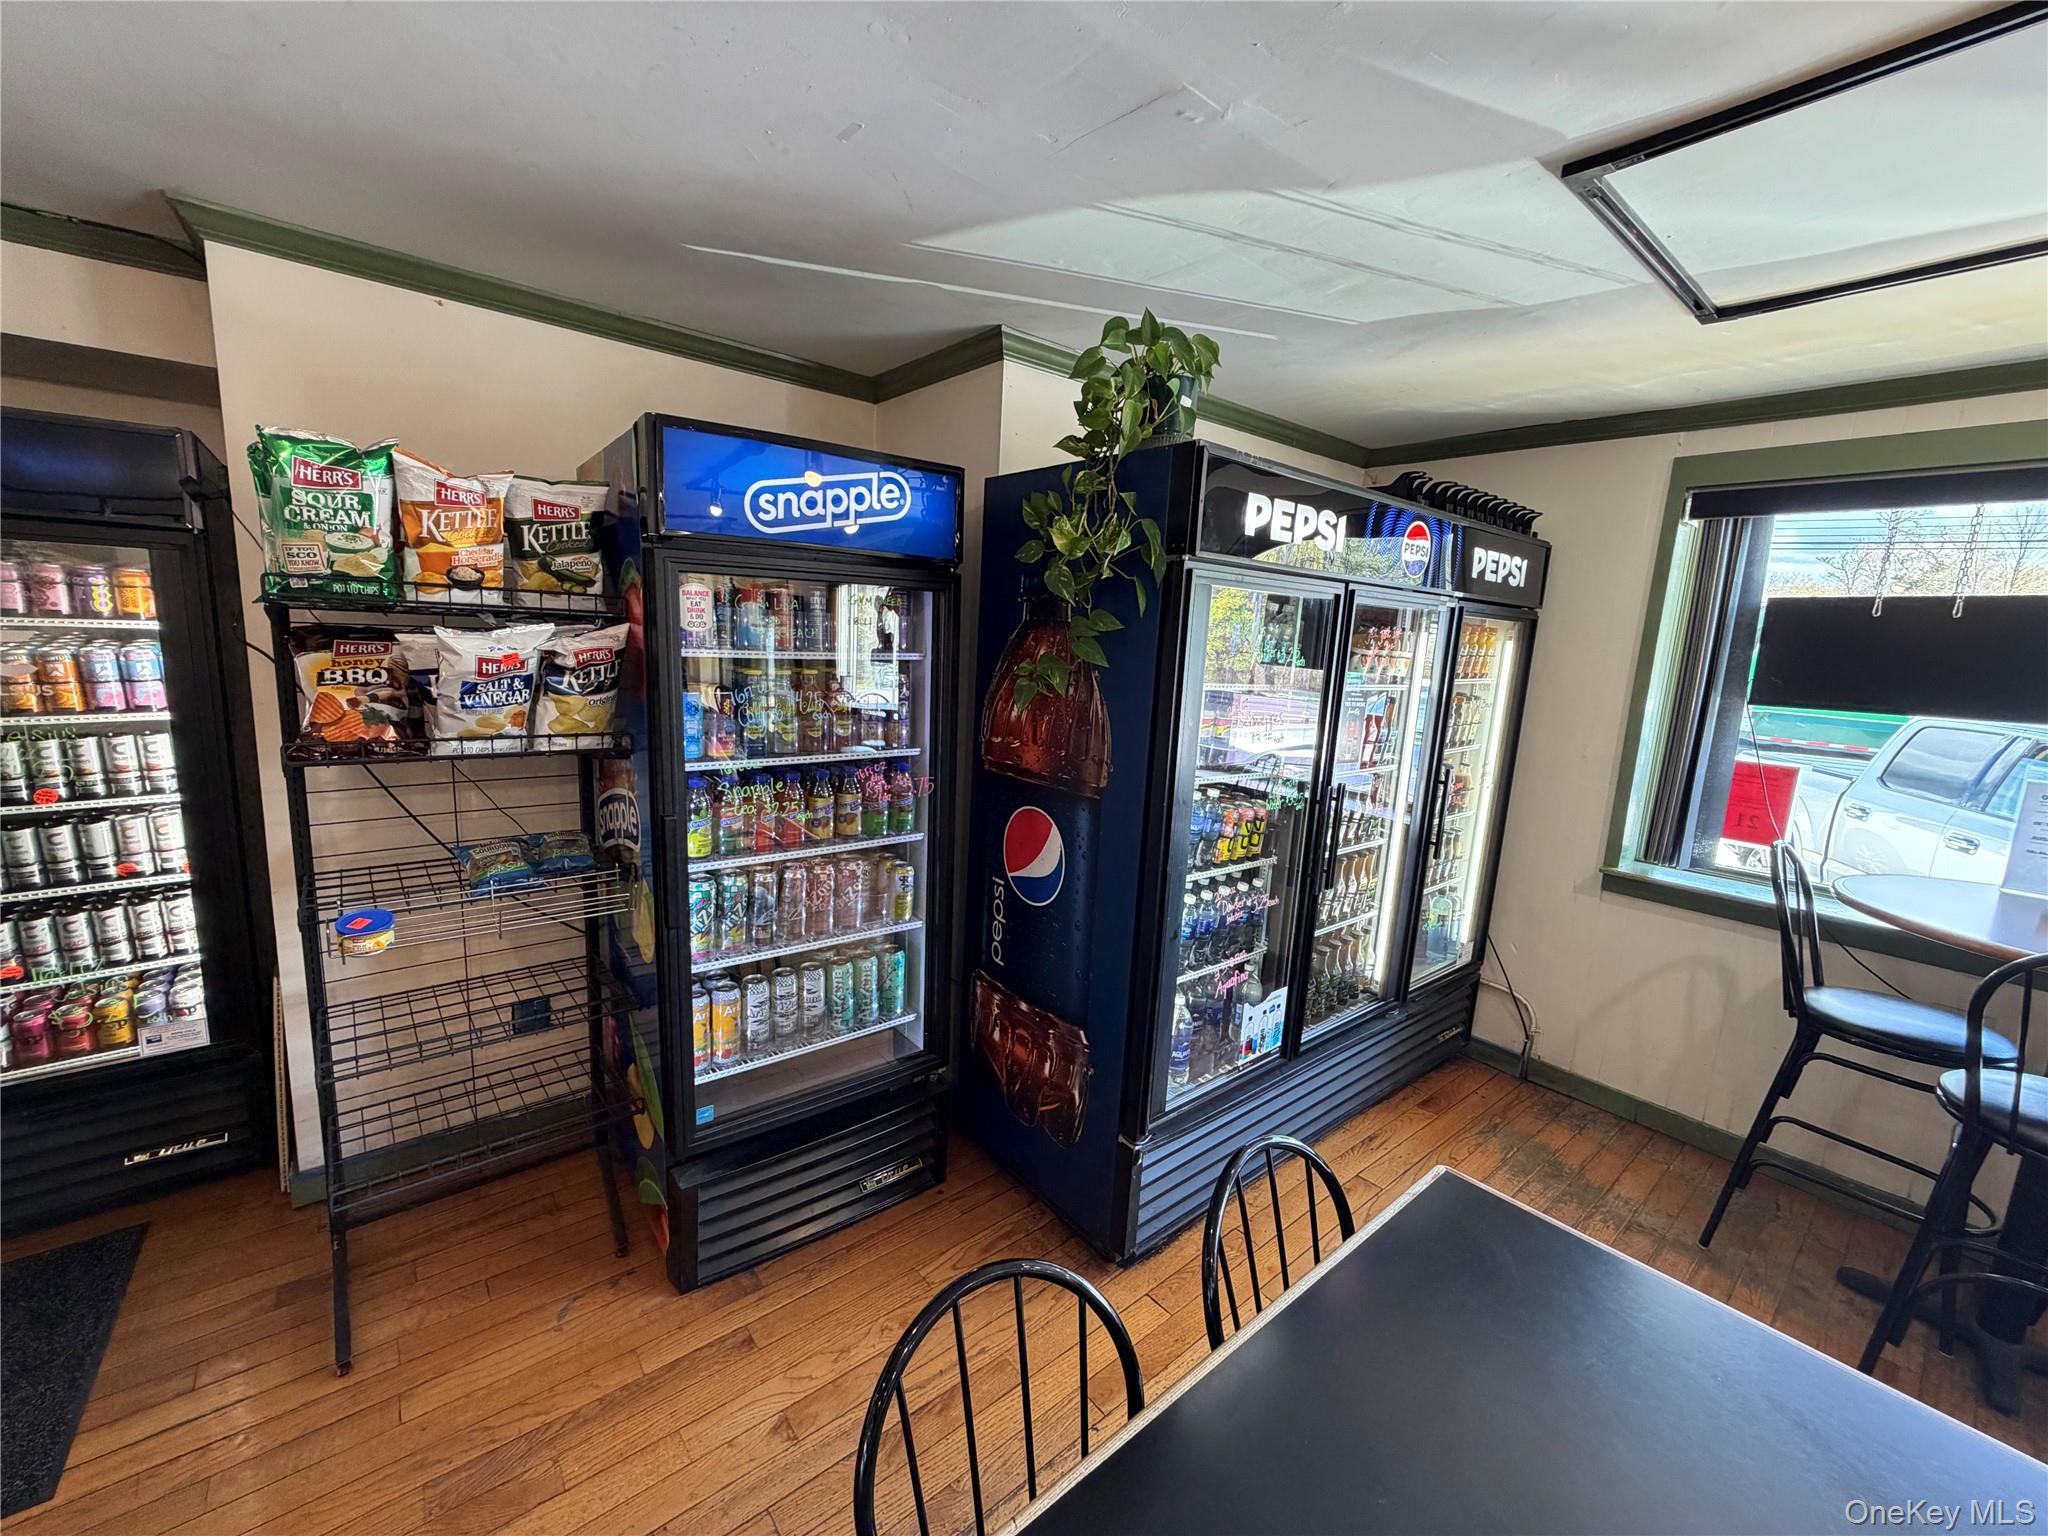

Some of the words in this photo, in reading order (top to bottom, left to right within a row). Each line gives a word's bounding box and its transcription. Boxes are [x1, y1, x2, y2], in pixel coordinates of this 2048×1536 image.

[299, 463, 354, 486] HERR'S
[291, 488, 362, 510] SOUR
[440, 488, 481, 505] HERR'S
[757, 474, 903, 525] snapple
[283, 504, 372, 528] CREAM
[537, 503, 576, 518] HERR'S
[1244, 492, 1347, 552] PEPSI
[520, 521, 591, 554] KETTLE
[286, 551, 318, 560] SCO
[1403, 543, 1429, 559] PEPSI
[1471, 547, 1528, 587] PEPSI
[339, 643, 384, 654] HERR'S
[578, 649, 612, 663] HERR'S
[331, 658, 387, 669] honey
[320, 667, 390, 686] BBQ
[477, 678, 511, 693] SALT
[512, 677, 525, 690] &
[463, 689, 530, 707] VINEGAR
[717, 777, 785, 804] Snapple
[600, 793, 638, 839] snapple
[992, 876, 1005, 965] pepsi
